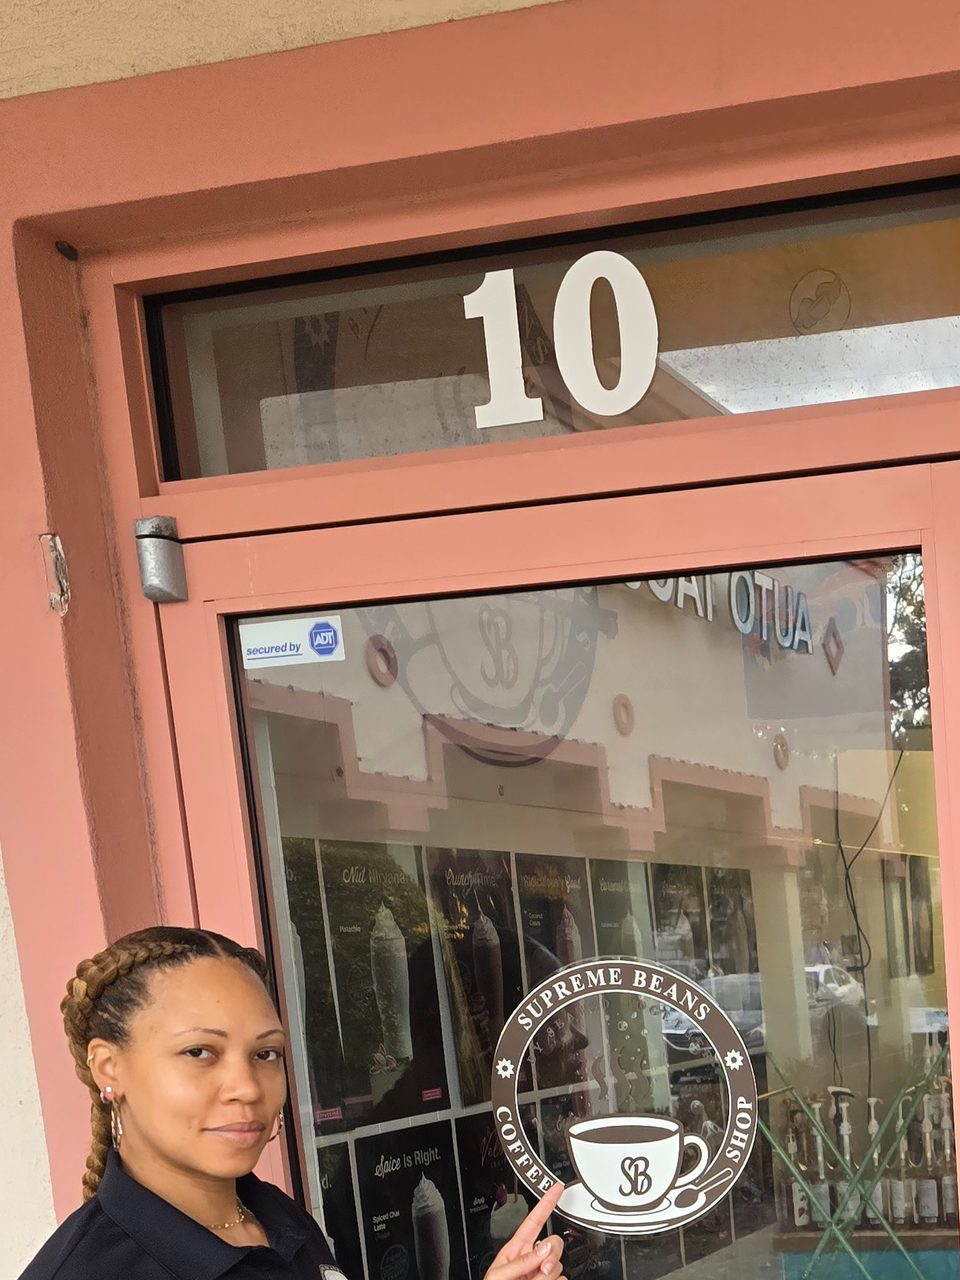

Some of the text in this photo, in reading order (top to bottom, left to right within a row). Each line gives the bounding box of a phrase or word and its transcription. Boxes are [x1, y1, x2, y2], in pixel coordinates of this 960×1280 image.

[463, 250, 659, 429] 10
[246, 632, 334, 656] secured by ADT
[517, 968, 623, 1031] SUPREME
[633, 969, 711, 1021] BEANS
[374, 1153, 402, 1179] Spice
[496, 1106, 555, 1192] COFFEE
[725, 1096, 753, 1163] SHOP
